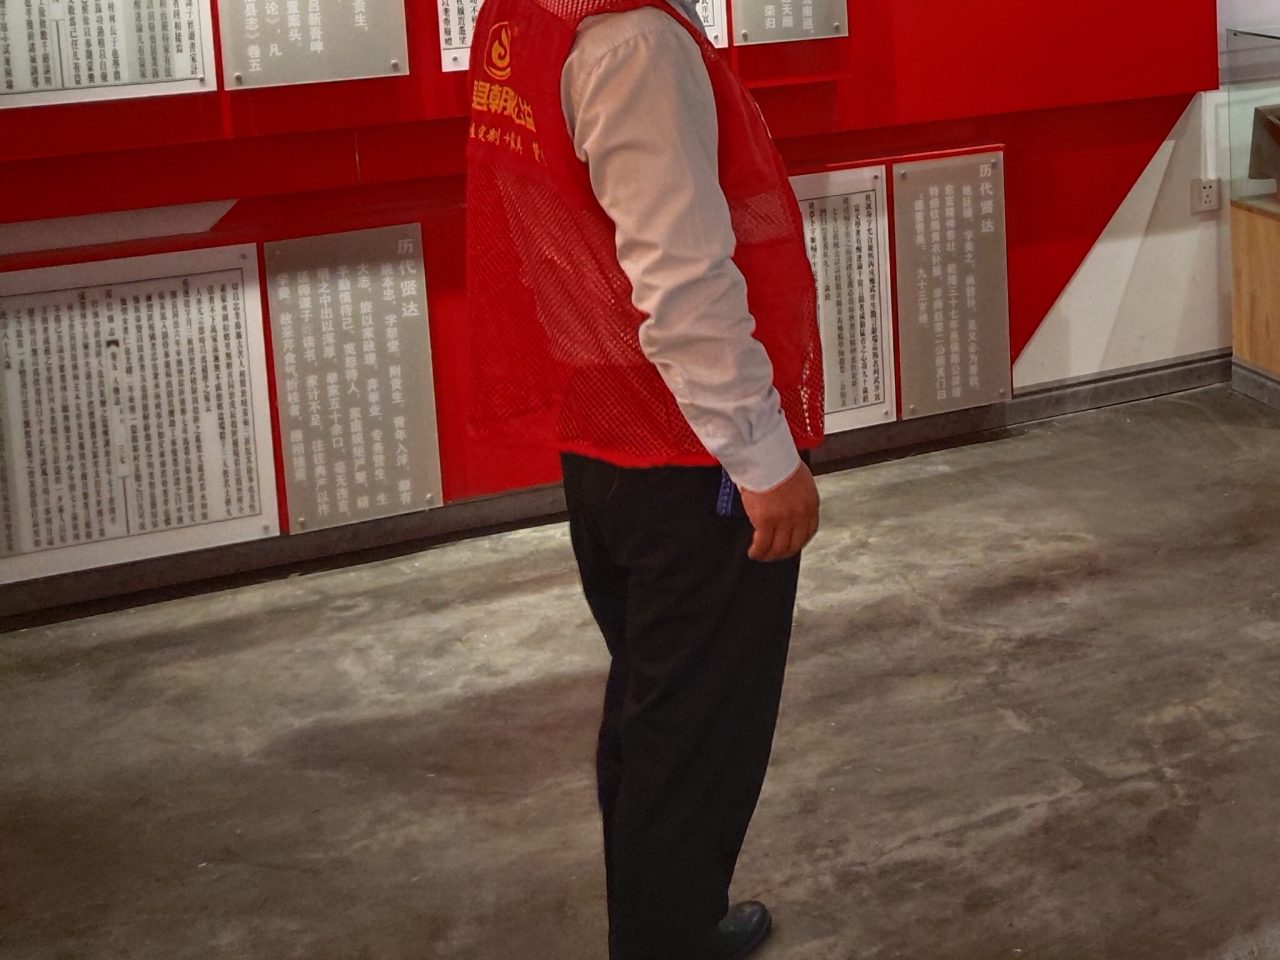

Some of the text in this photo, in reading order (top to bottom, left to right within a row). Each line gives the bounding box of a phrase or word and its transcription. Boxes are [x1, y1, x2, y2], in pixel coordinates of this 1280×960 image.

[979, 163, 995, 234] 历代贤达
[398, 236, 420, 318] 历代贤达
